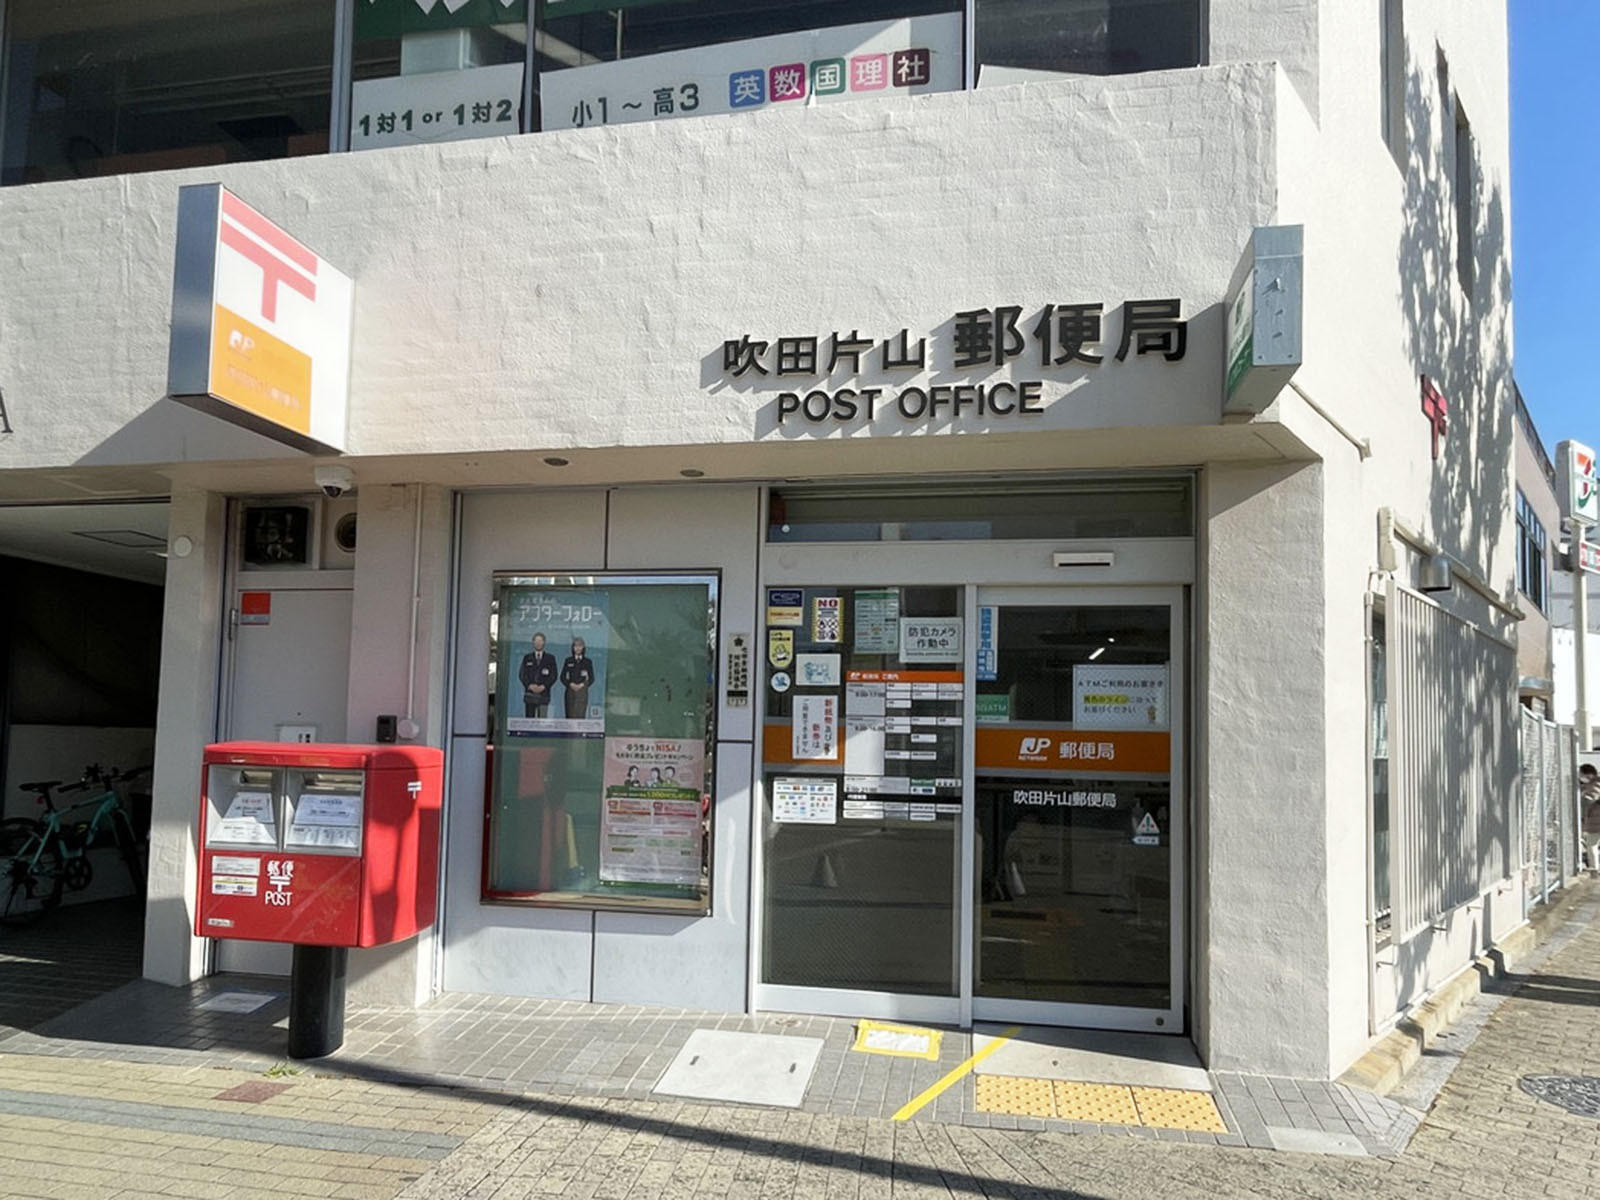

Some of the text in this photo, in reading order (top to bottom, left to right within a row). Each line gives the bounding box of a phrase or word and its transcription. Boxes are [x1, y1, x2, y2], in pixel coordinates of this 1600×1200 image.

[733, 55, 926, 102] 英数国理社
[359, 99, 512, 136] 1対1 or 1対2
[777, 381, 1045, 423] POST OFFICE
[519, 605, 602, 622] アフターフォロー
[908, 627, 956, 637] 防犯カメラ
[917, 638, 949, 648] 作動中
[1059, 741, 1115, 760] 郵便局
[1013, 790, 1117, 808] 吹田片山郵便局
[265, 890, 293, 906] POST
